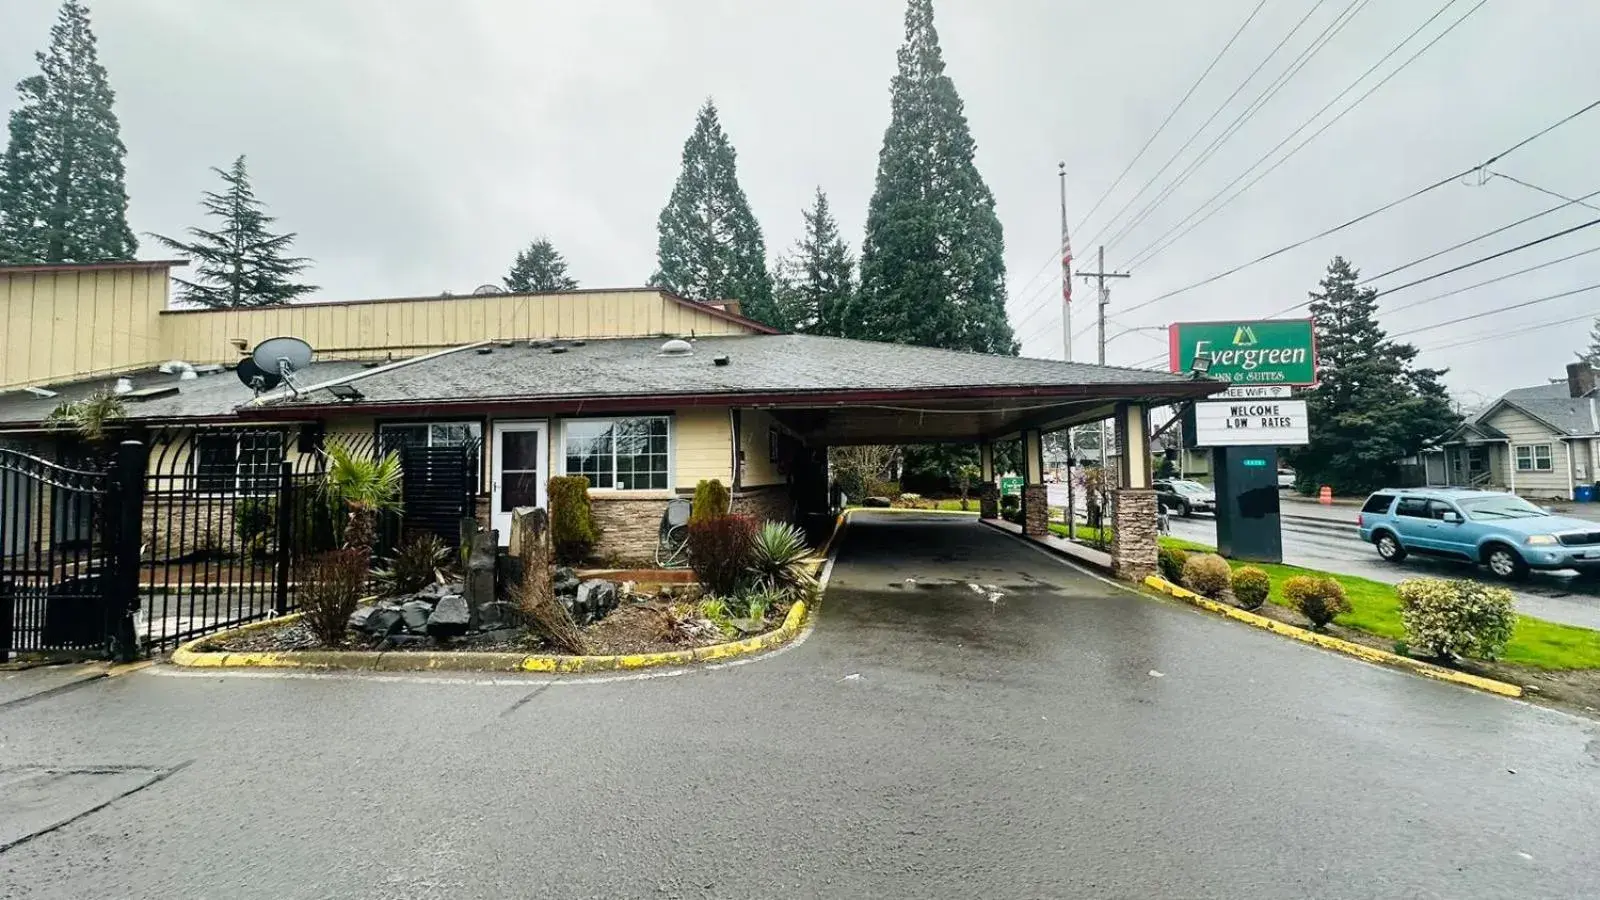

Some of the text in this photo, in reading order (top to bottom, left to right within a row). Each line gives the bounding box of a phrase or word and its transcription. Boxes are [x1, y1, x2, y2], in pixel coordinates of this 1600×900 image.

[1194, 340, 1306, 370] Evergreen
[1230, 405, 1280, 417] WELCOME
[1226, 417, 1291, 429] LOW RATES
